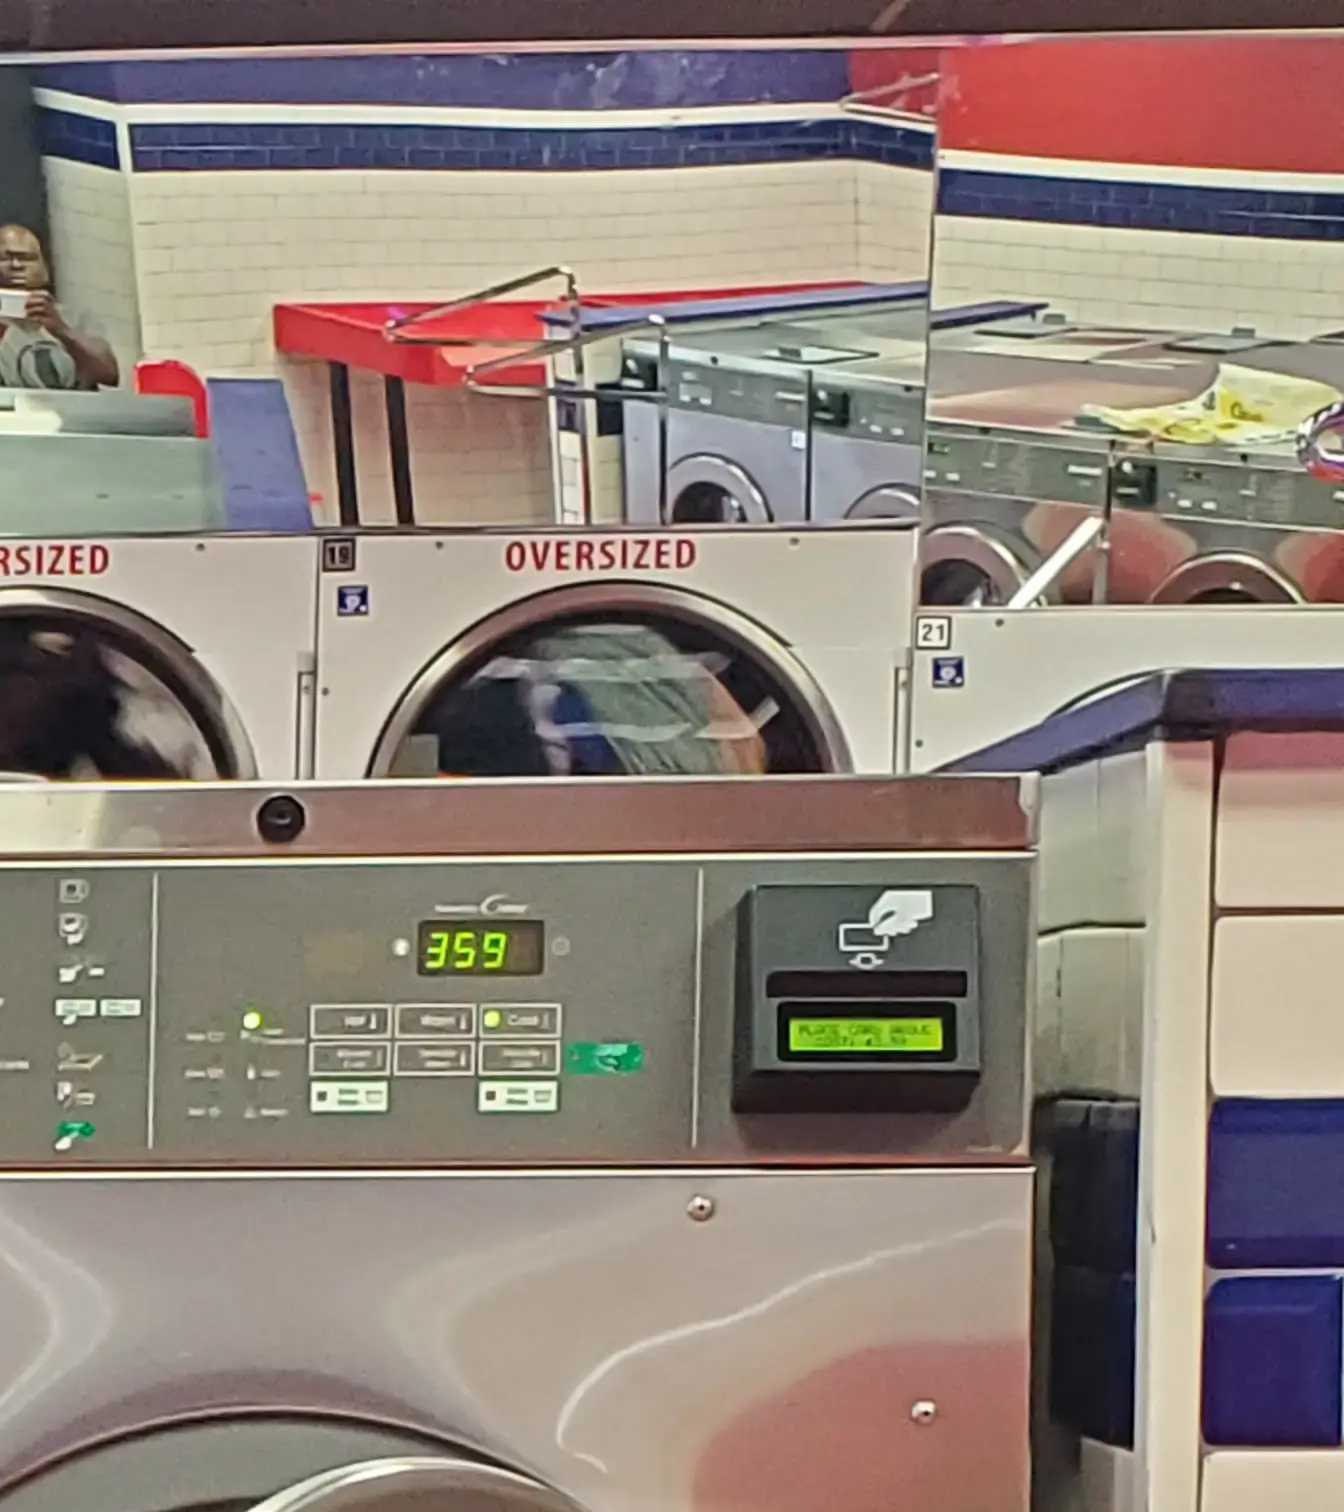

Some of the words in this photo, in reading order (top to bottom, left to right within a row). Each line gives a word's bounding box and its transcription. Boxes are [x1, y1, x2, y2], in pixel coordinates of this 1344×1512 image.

[505, 539, 696, 571] OVERSIZED
[922, 624, 944, 641] 21
[425, 932, 507, 968] 359
